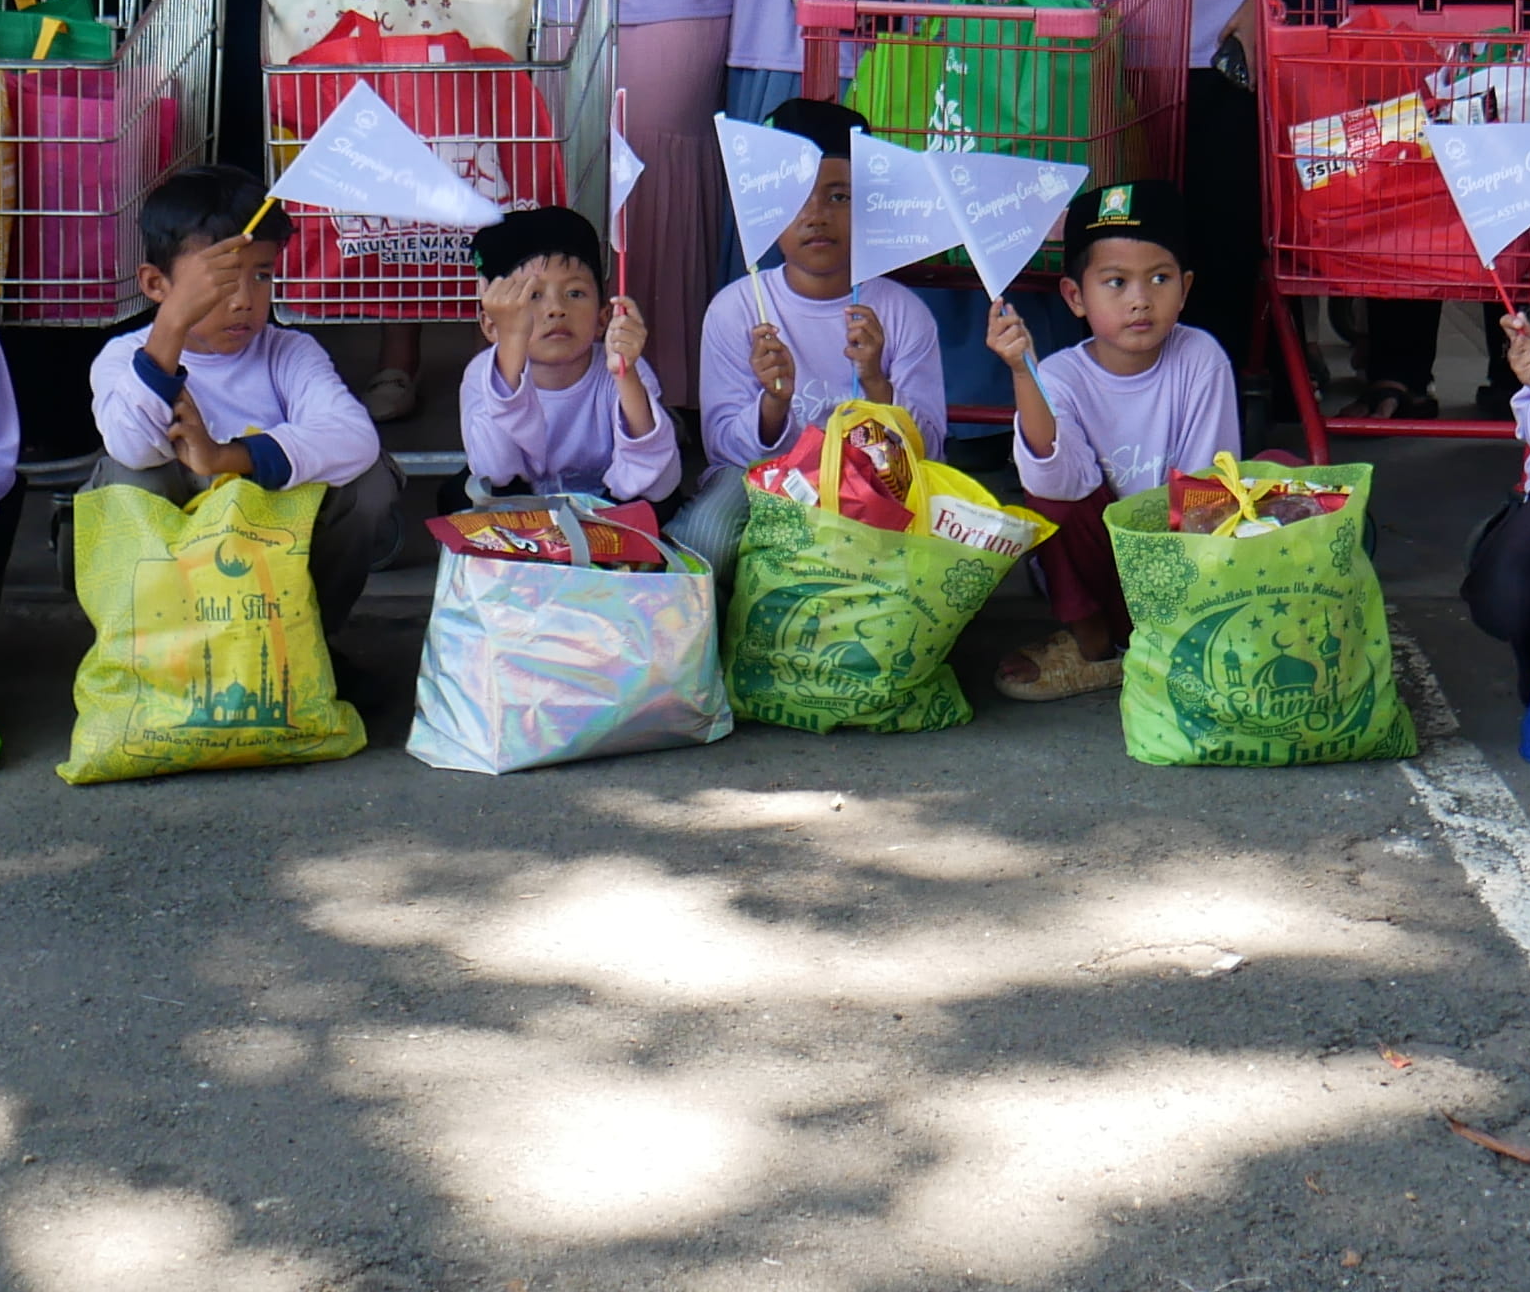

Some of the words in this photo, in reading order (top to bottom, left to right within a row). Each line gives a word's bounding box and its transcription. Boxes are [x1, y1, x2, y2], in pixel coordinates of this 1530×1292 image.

[1456, 167, 1524, 198] Shopping
[866, 192, 935, 217] Shopping
[966, 193, 1017, 225] Shopping
[1016, 179, 1042, 202] Ceria
[1497, 199, 1530, 221] ASTRA
[341, 238, 401, 257] YAKULT
[406, 237, 458, 249] ENAK
[895, 234, 931, 246] ASTRA
[380, 251, 439, 264] SETIAP
[932, 507, 1024, 560] Fortune
[194, 596, 233, 622] Idul
[241, 593, 284, 623] Fitri
[1212, 681, 1339, 733] Selamat
